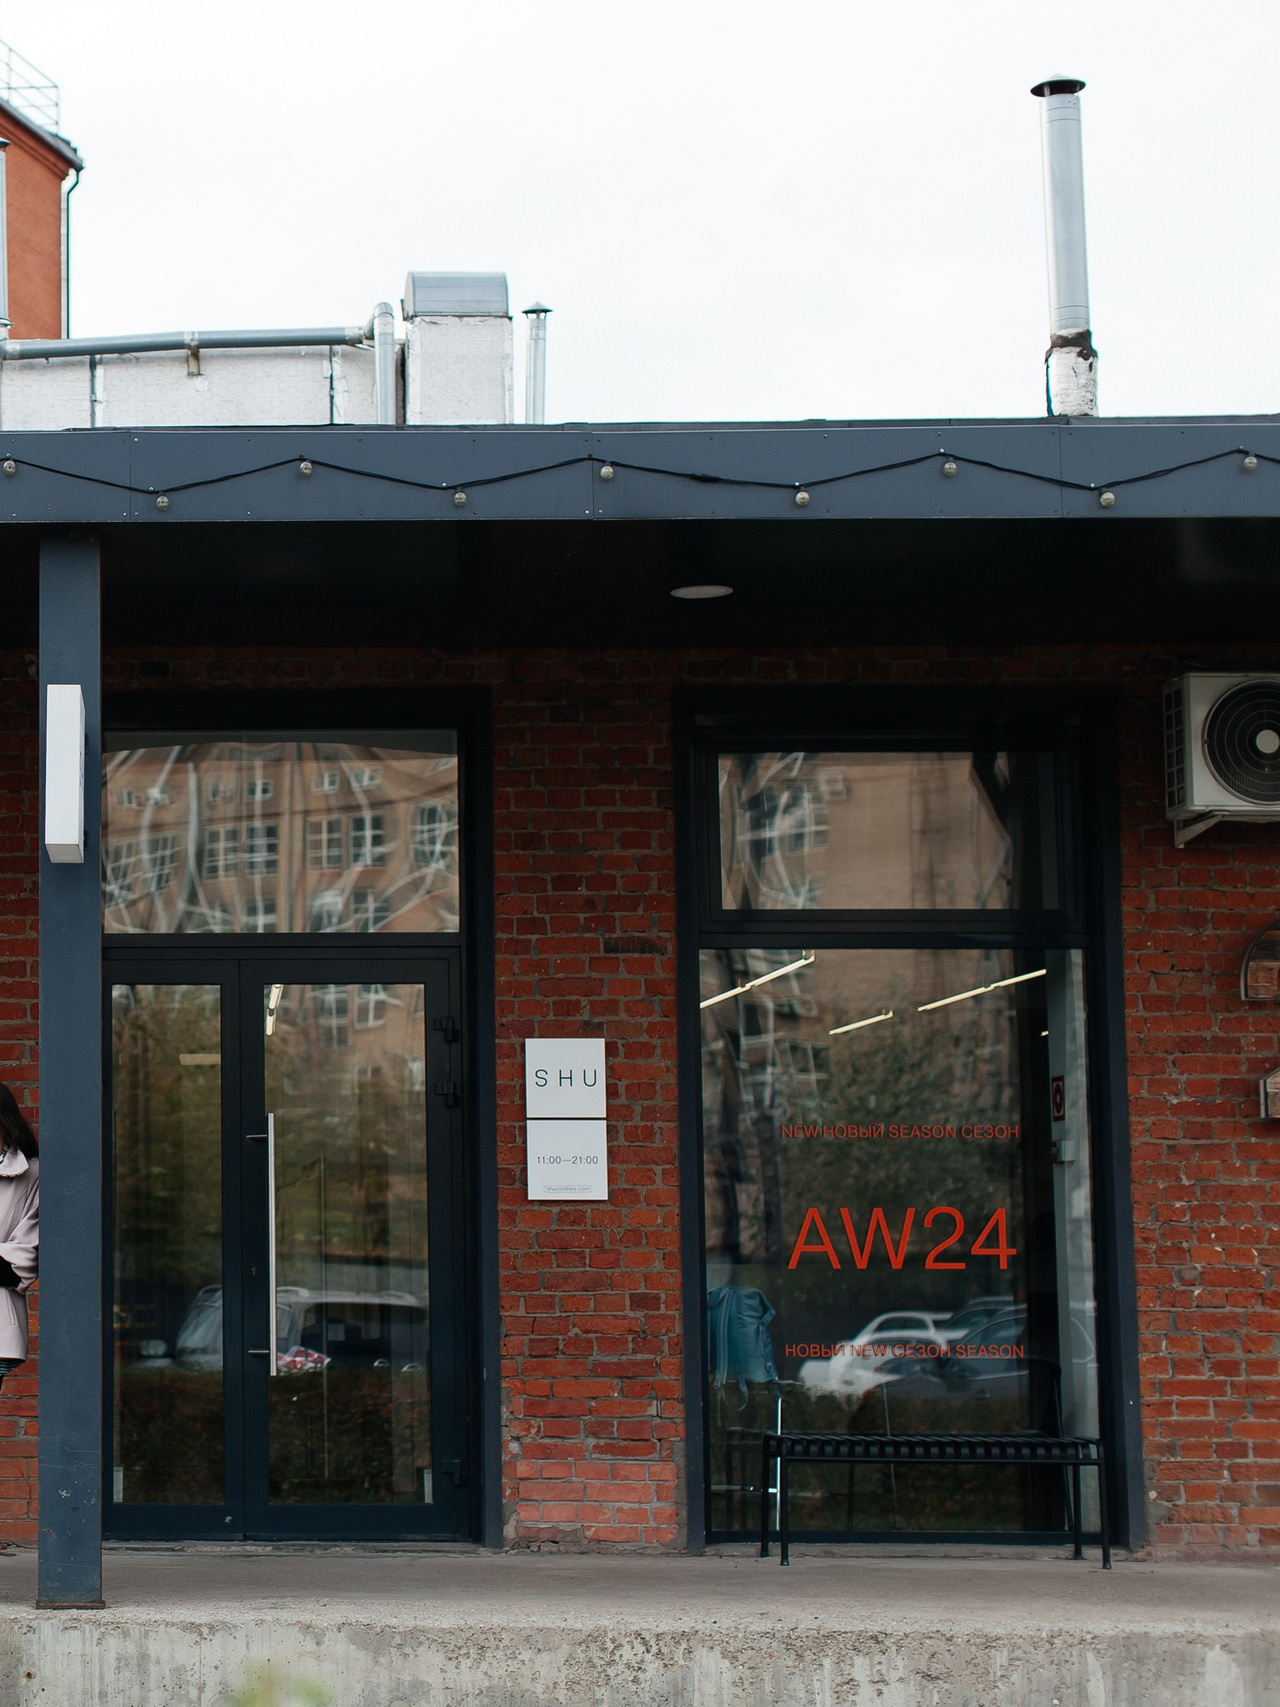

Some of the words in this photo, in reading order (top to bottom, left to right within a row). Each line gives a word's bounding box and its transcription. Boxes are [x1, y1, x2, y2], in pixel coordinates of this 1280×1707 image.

[535, 1069, 597, 1087] SHU
[781, 1125, 819, 1138] NEW
[823, 1122, 884, 1138] НОВЫЙ
[888, 1124, 957, 1138] SEASON
[961, 1124, 1019, 1138] СЕЗОН
[787, 1206, 1017, 1270] AW24
[785, 1341, 846, 1357] НОВЫЙ
[850, 1344, 888, 1357] NEW
[892, 1343, 950, 1358] СЕЗОН
[955, 1344, 1024, 1358] SEASON
